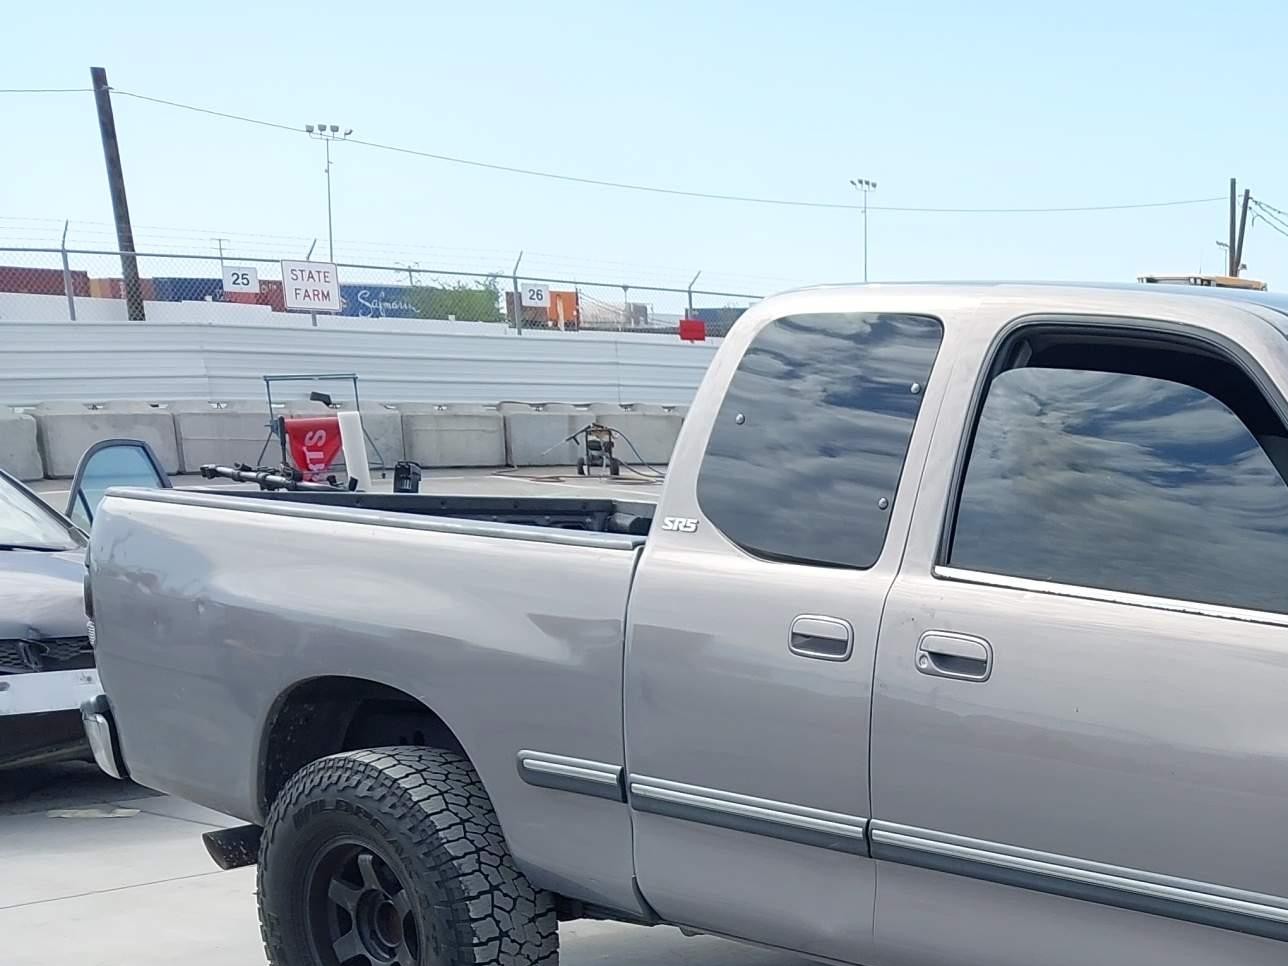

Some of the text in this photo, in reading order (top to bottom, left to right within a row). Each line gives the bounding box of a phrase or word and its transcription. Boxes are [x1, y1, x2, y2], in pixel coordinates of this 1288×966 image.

[231, 272, 250, 286] 25
[290, 268, 331, 283] STATE
[294, 287, 331, 302] FARM
[528, 288, 544, 301] 26
[662, 516, 698, 533] SR5
